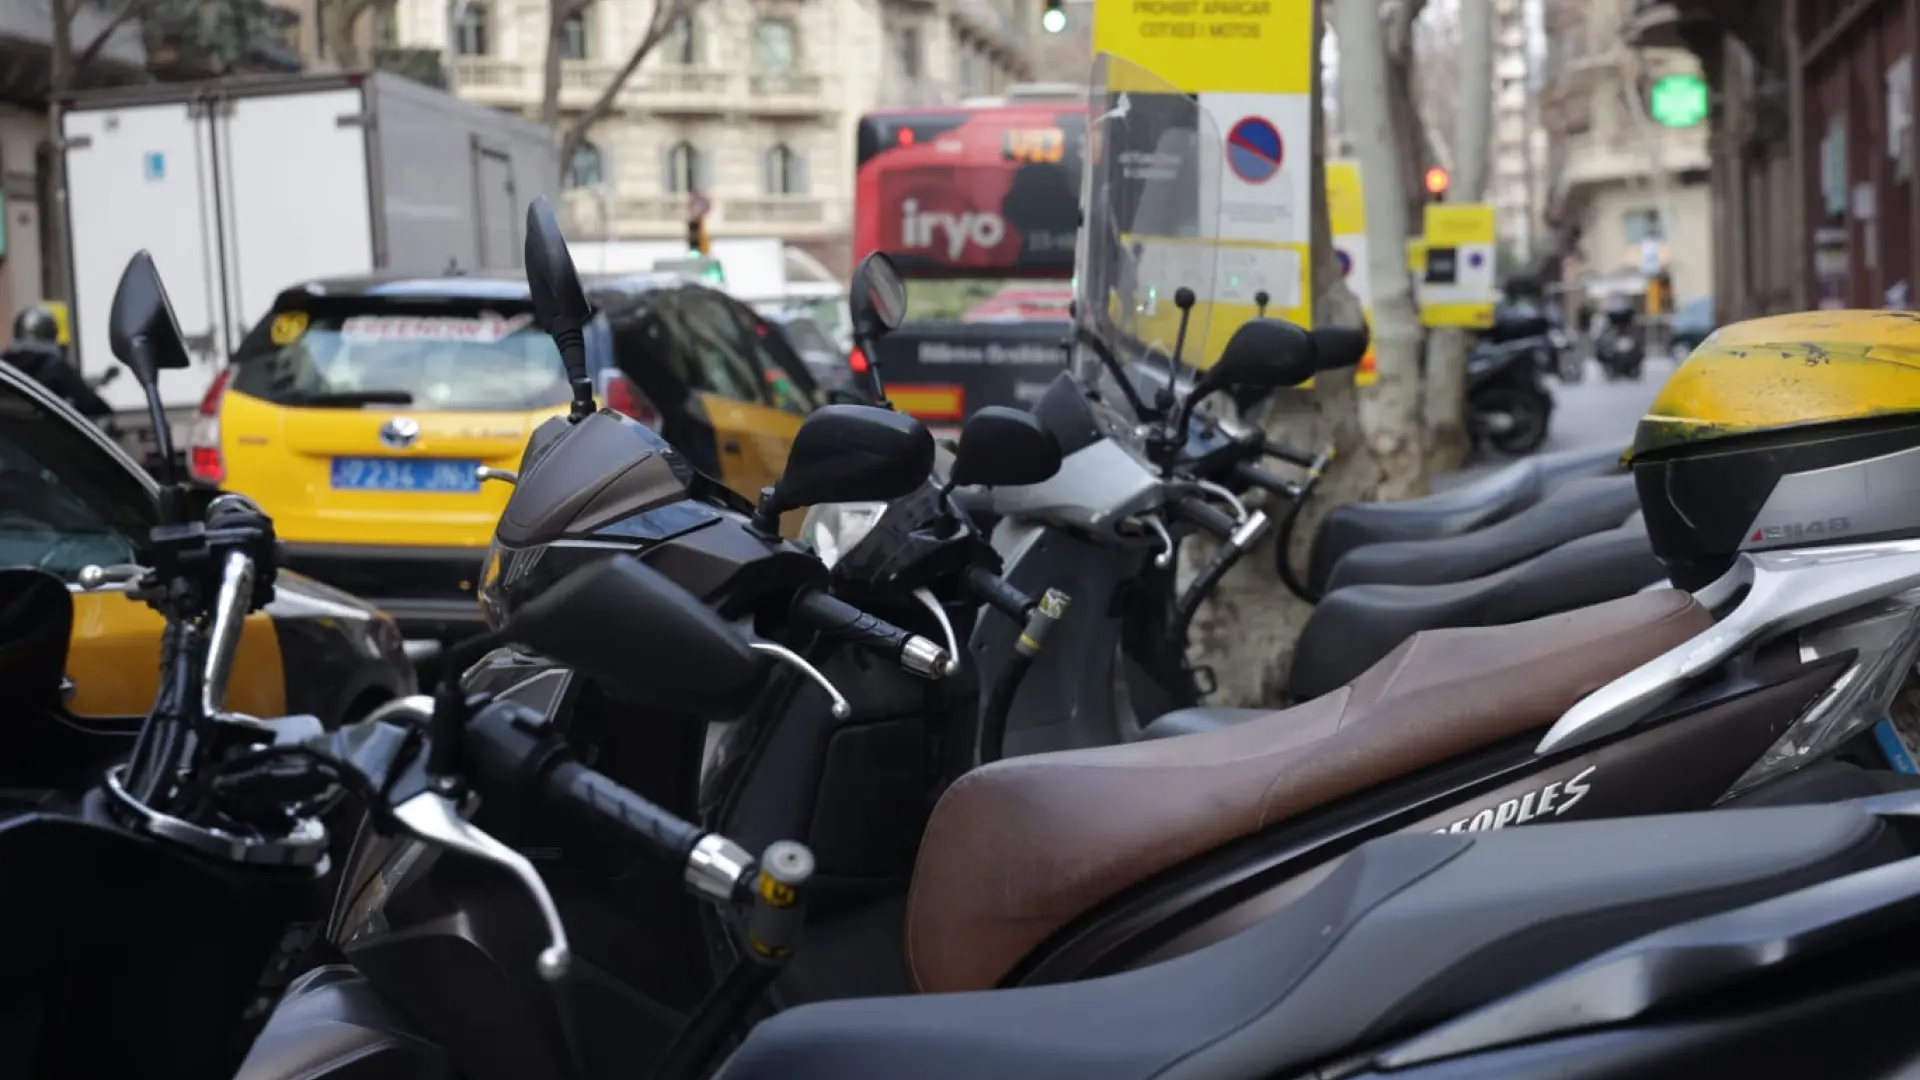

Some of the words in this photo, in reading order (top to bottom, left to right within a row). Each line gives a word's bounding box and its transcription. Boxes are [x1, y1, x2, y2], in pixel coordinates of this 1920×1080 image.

[1203, 0, 1271, 15] APARCAR
[1209, 22, 1262, 38] MOTOS
[902, 199, 1005, 262] iryo
